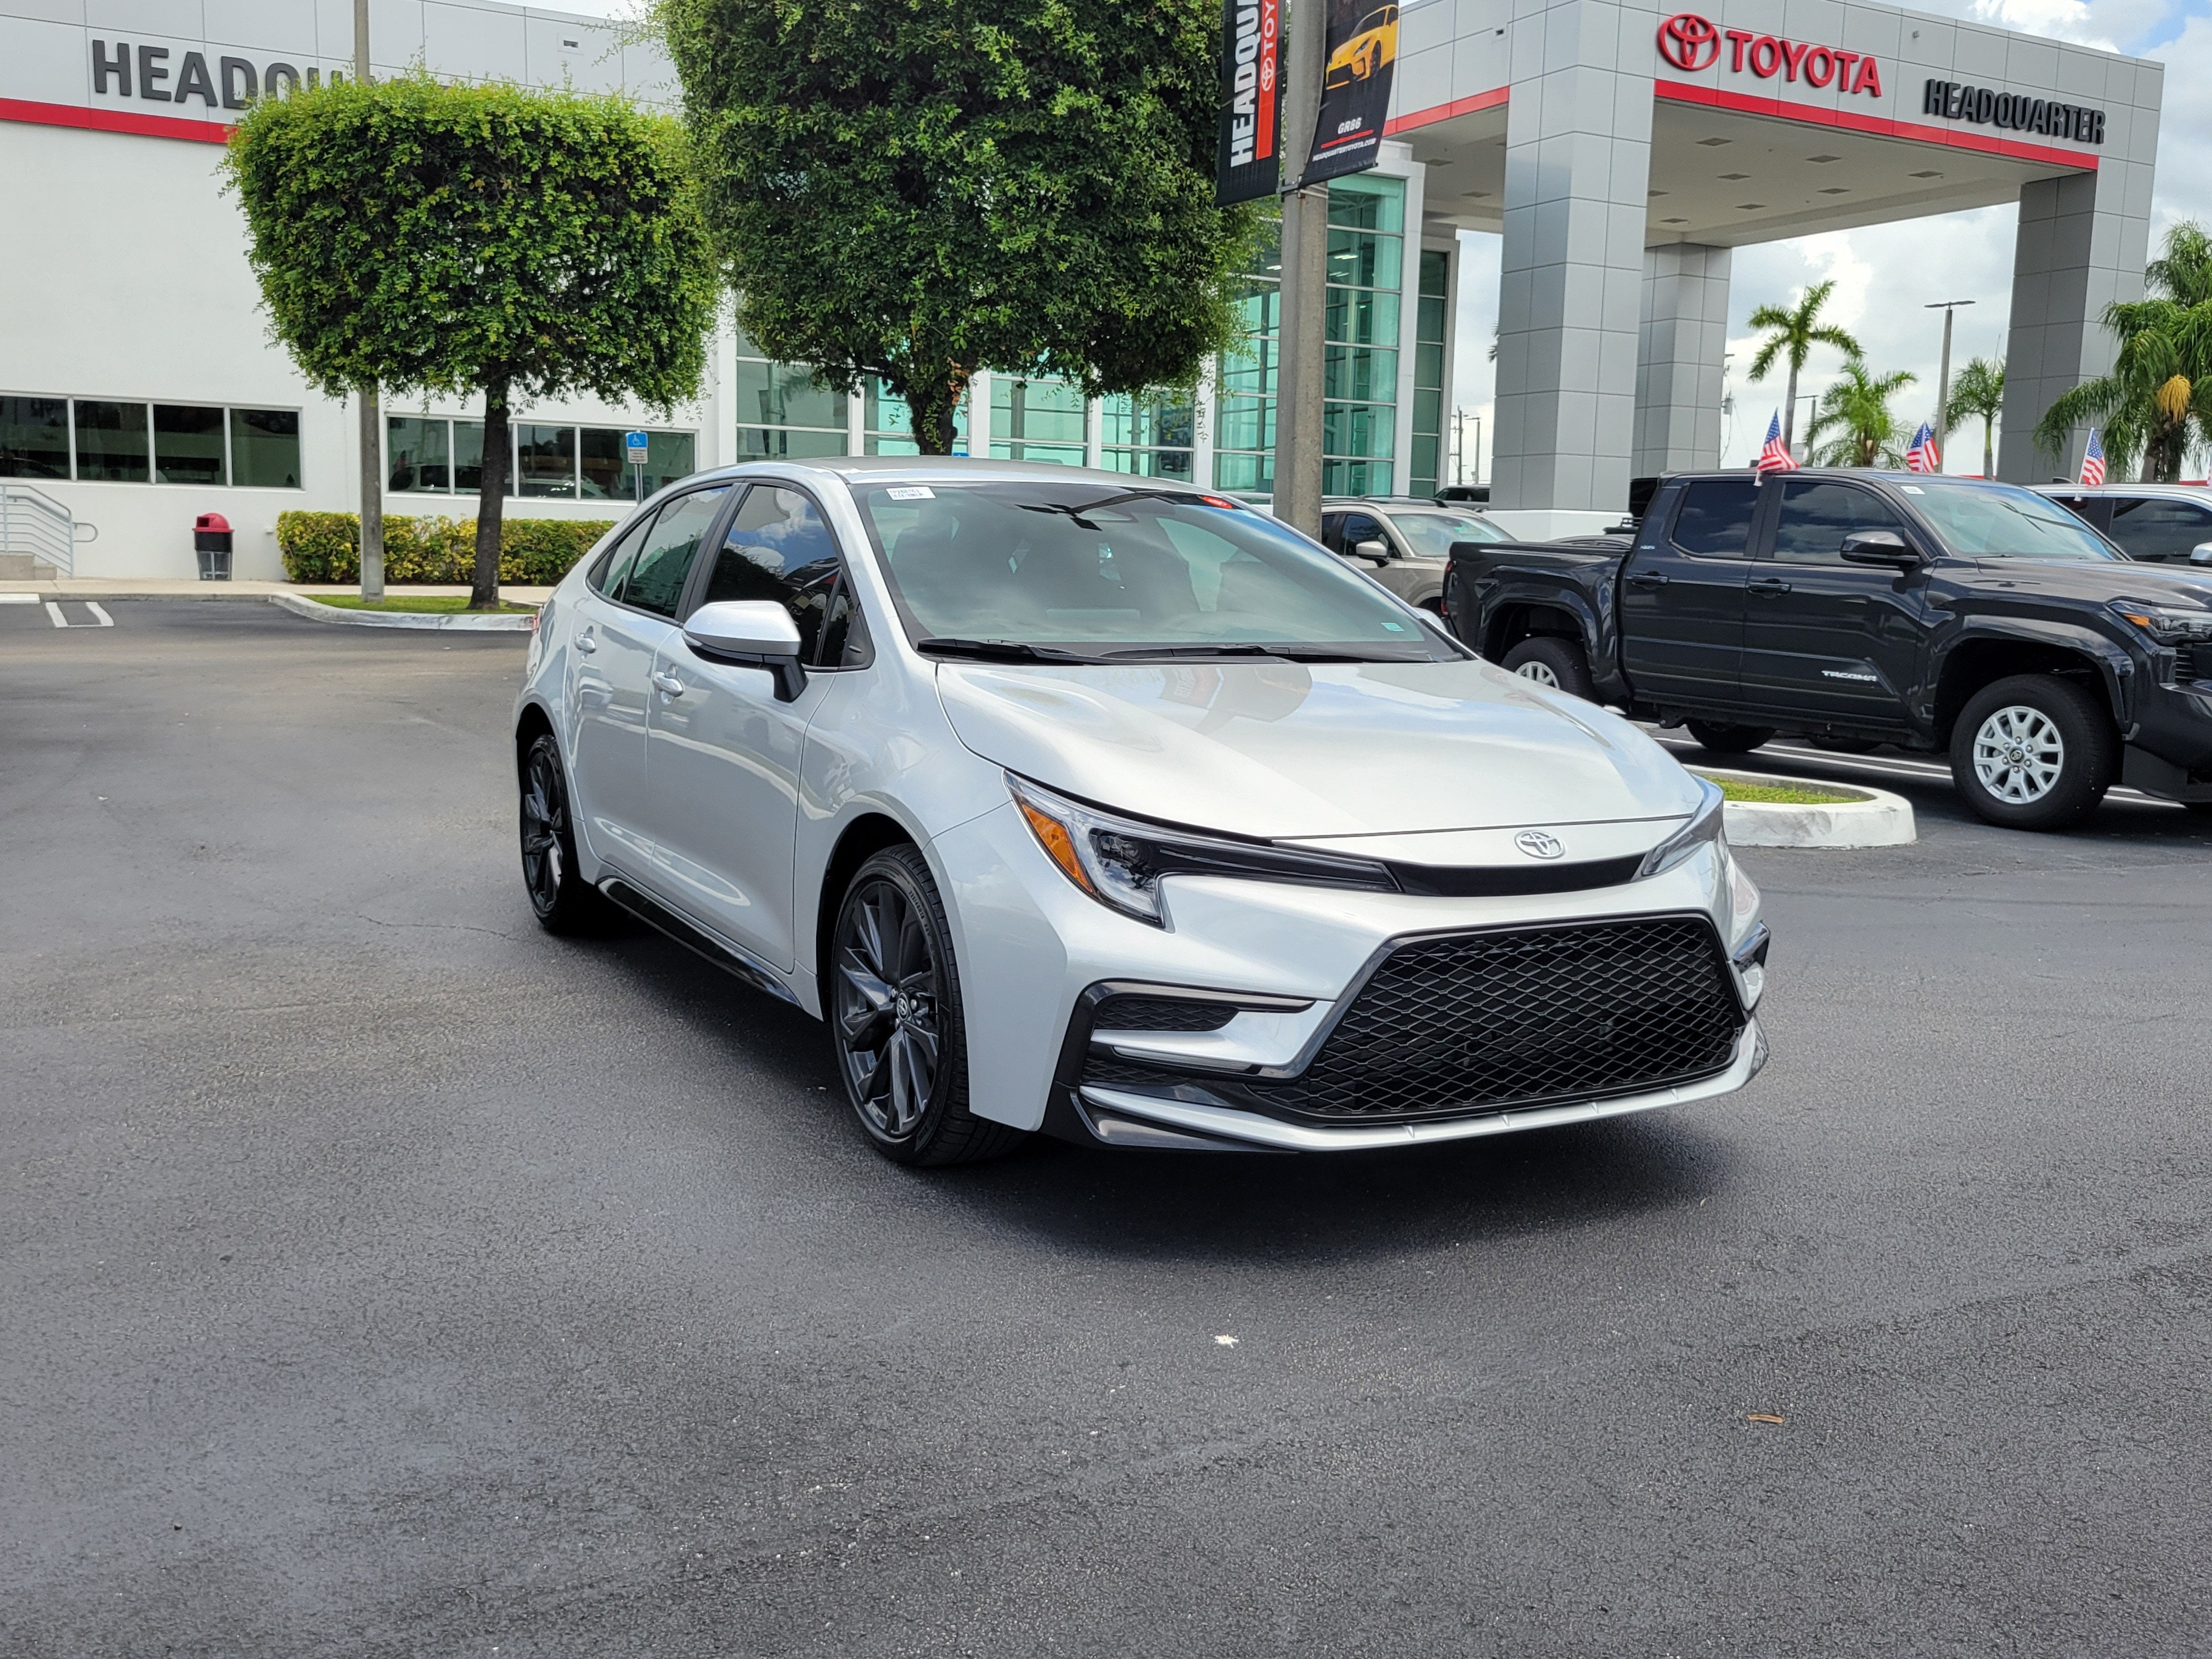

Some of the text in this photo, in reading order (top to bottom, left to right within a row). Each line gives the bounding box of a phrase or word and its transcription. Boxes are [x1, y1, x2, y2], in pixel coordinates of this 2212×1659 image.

[1231, 0, 1261, 167] HEADQU
[1726, 30, 1882, 98] TOYOTA
[1338, 117, 1363, 135] GR86
[1923, 78, 2107, 145] HEADQUARTER
[1821, 670, 1877, 682] TACOMA
